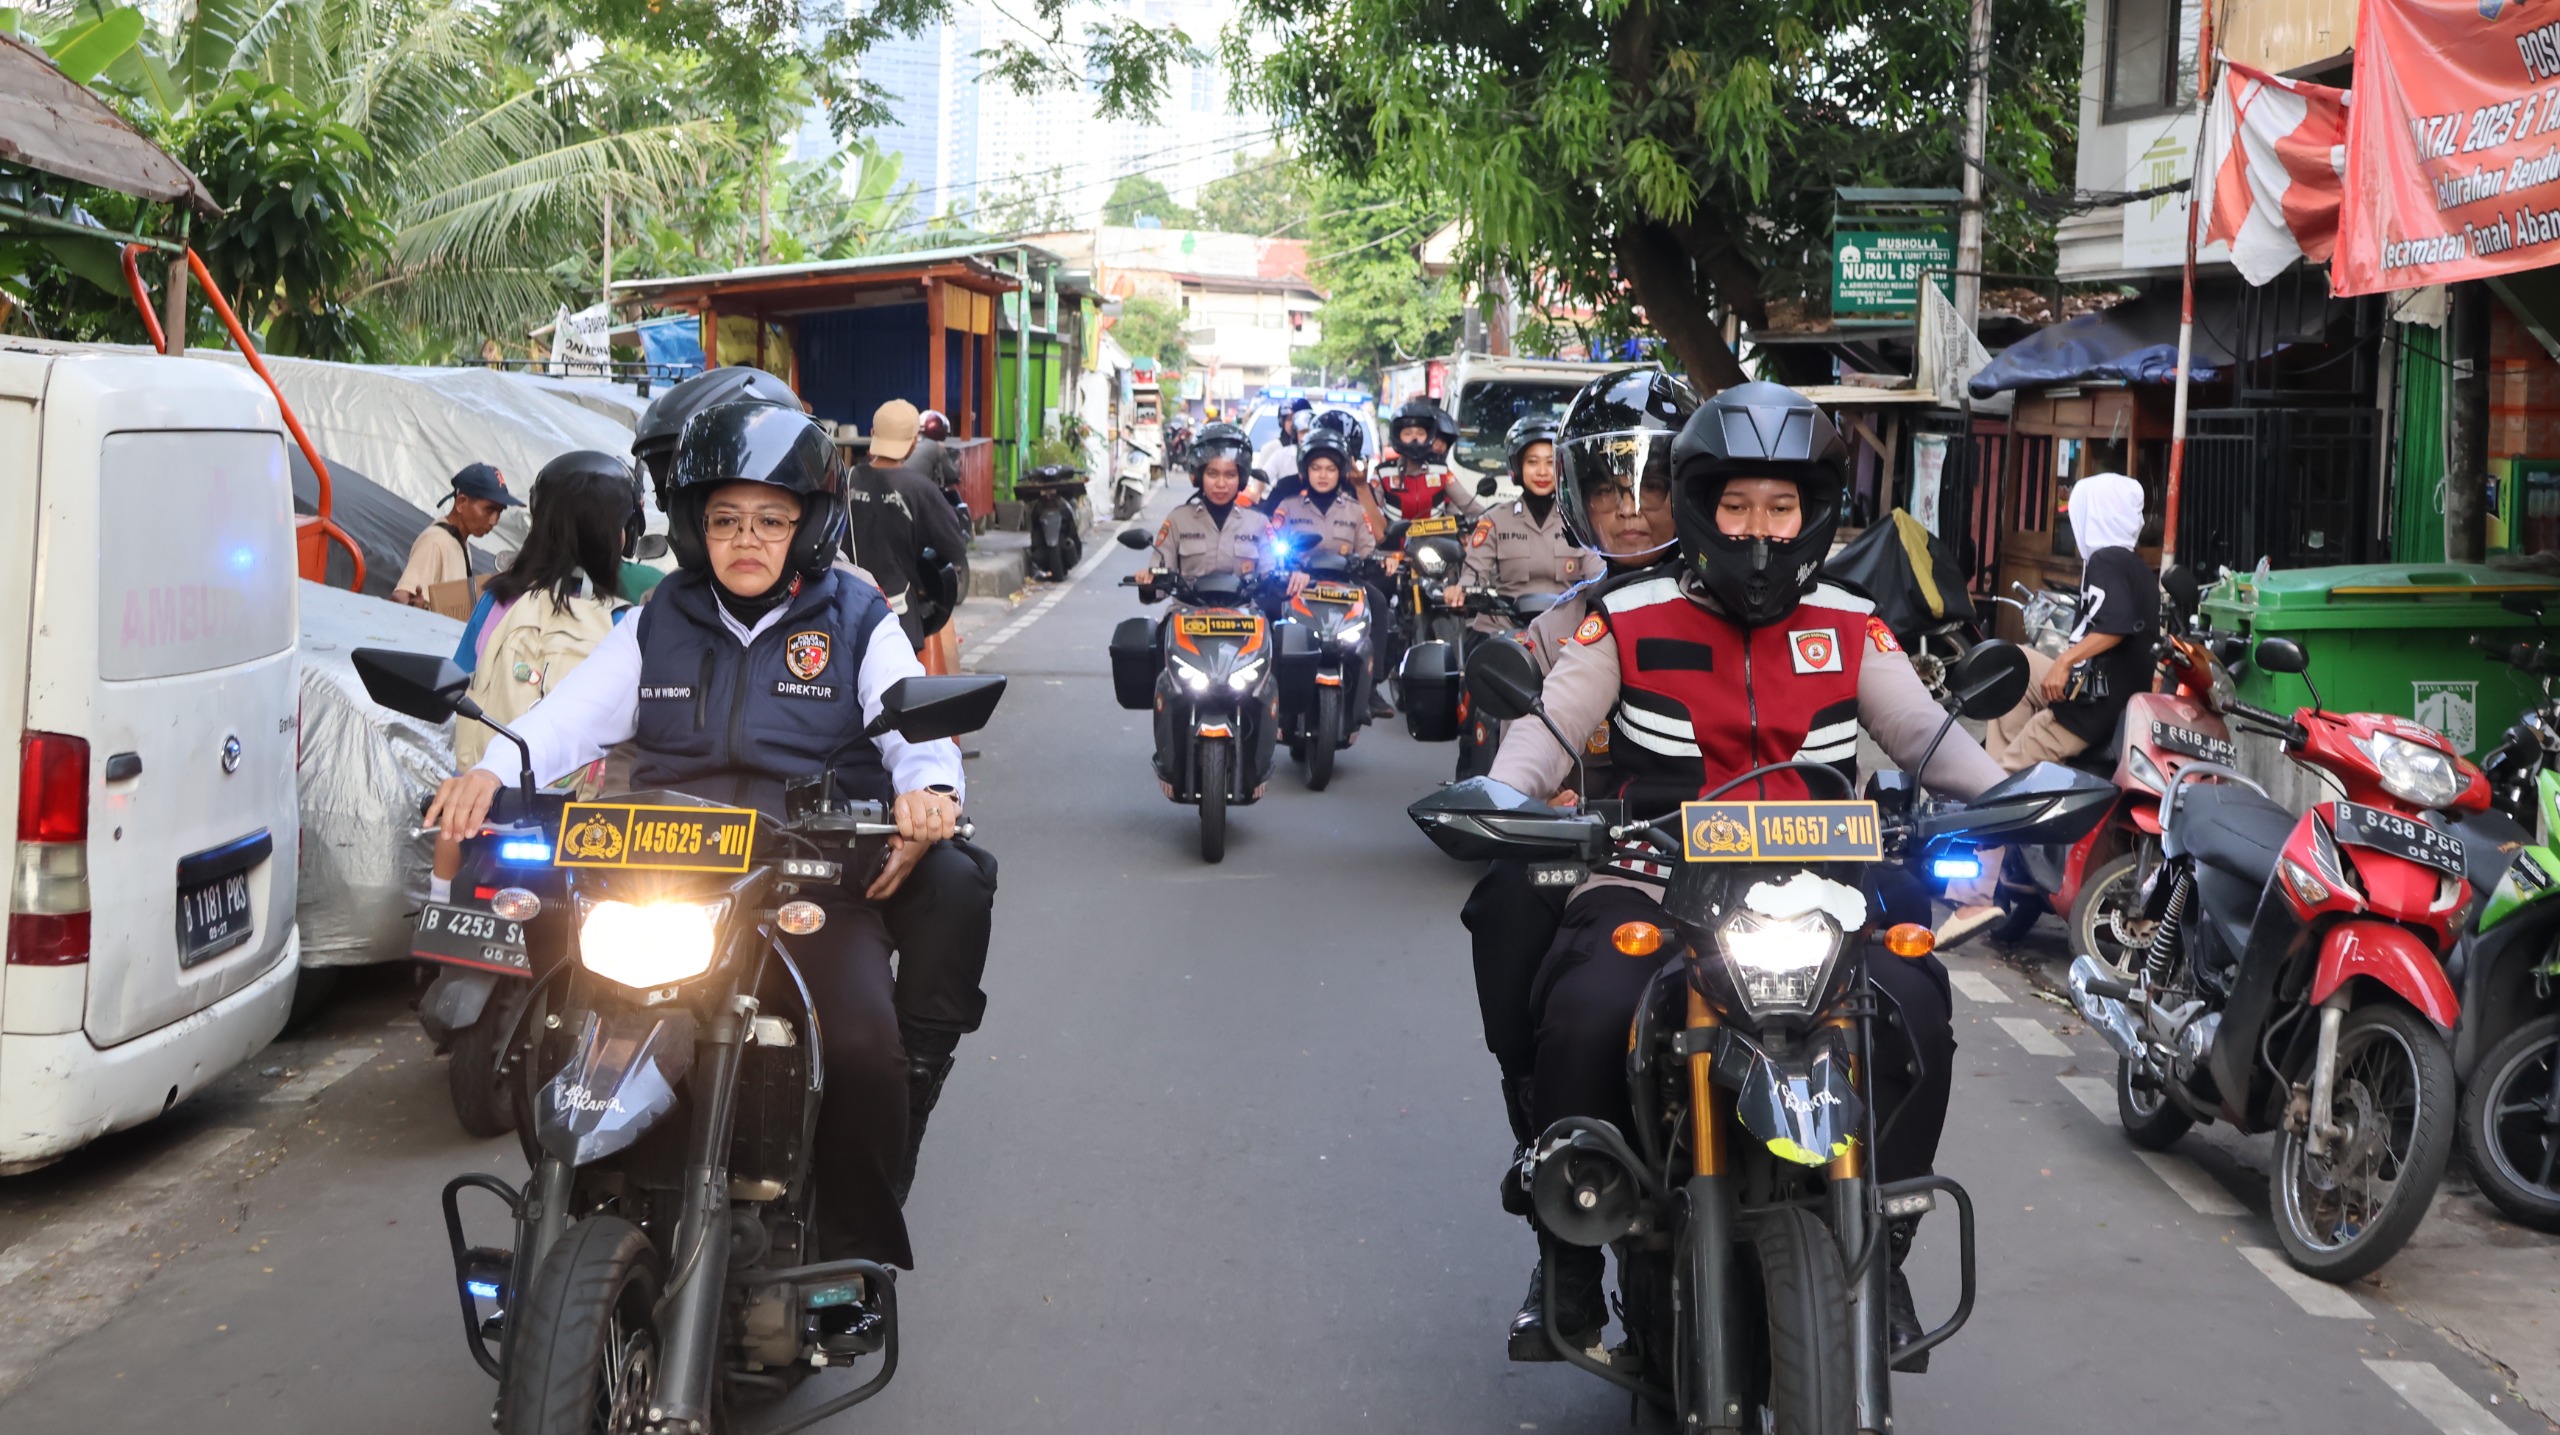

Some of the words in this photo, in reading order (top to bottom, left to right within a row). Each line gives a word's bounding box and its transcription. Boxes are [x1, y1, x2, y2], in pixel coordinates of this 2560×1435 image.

[2461, 98, 2522, 154] 2025
[1865, 251, 1882, 260] TKA
[1888, 251, 1903, 260] TPA
[1877, 239, 1938, 248] MUSHOLLA
[2380, 232, 2466, 270] Kecamatan
[2465, 212, 2512, 257] Tanah
[1843, 263, 1896, 280] NURUL
[662, 687, 691, 698] WIBOWO
[777, 681, 832, 698] DIREKTUR
[2153, 721, 2162, 734] B
[1761, 816, 1828, 845] 145657
[1845, 815, 1873, 844] VII
[2340, 804, 2352, 820] B
[2366, 811, 2416, 840] 6438
[634, 821, 702, 854] 145625
[719, 825, 746, 855] VII
[184, 895, 193, 932] B
[197, 883, 222, 926] 1181
[427, 909, 439, 929] B
[447, 913, 496, 939] 4253
